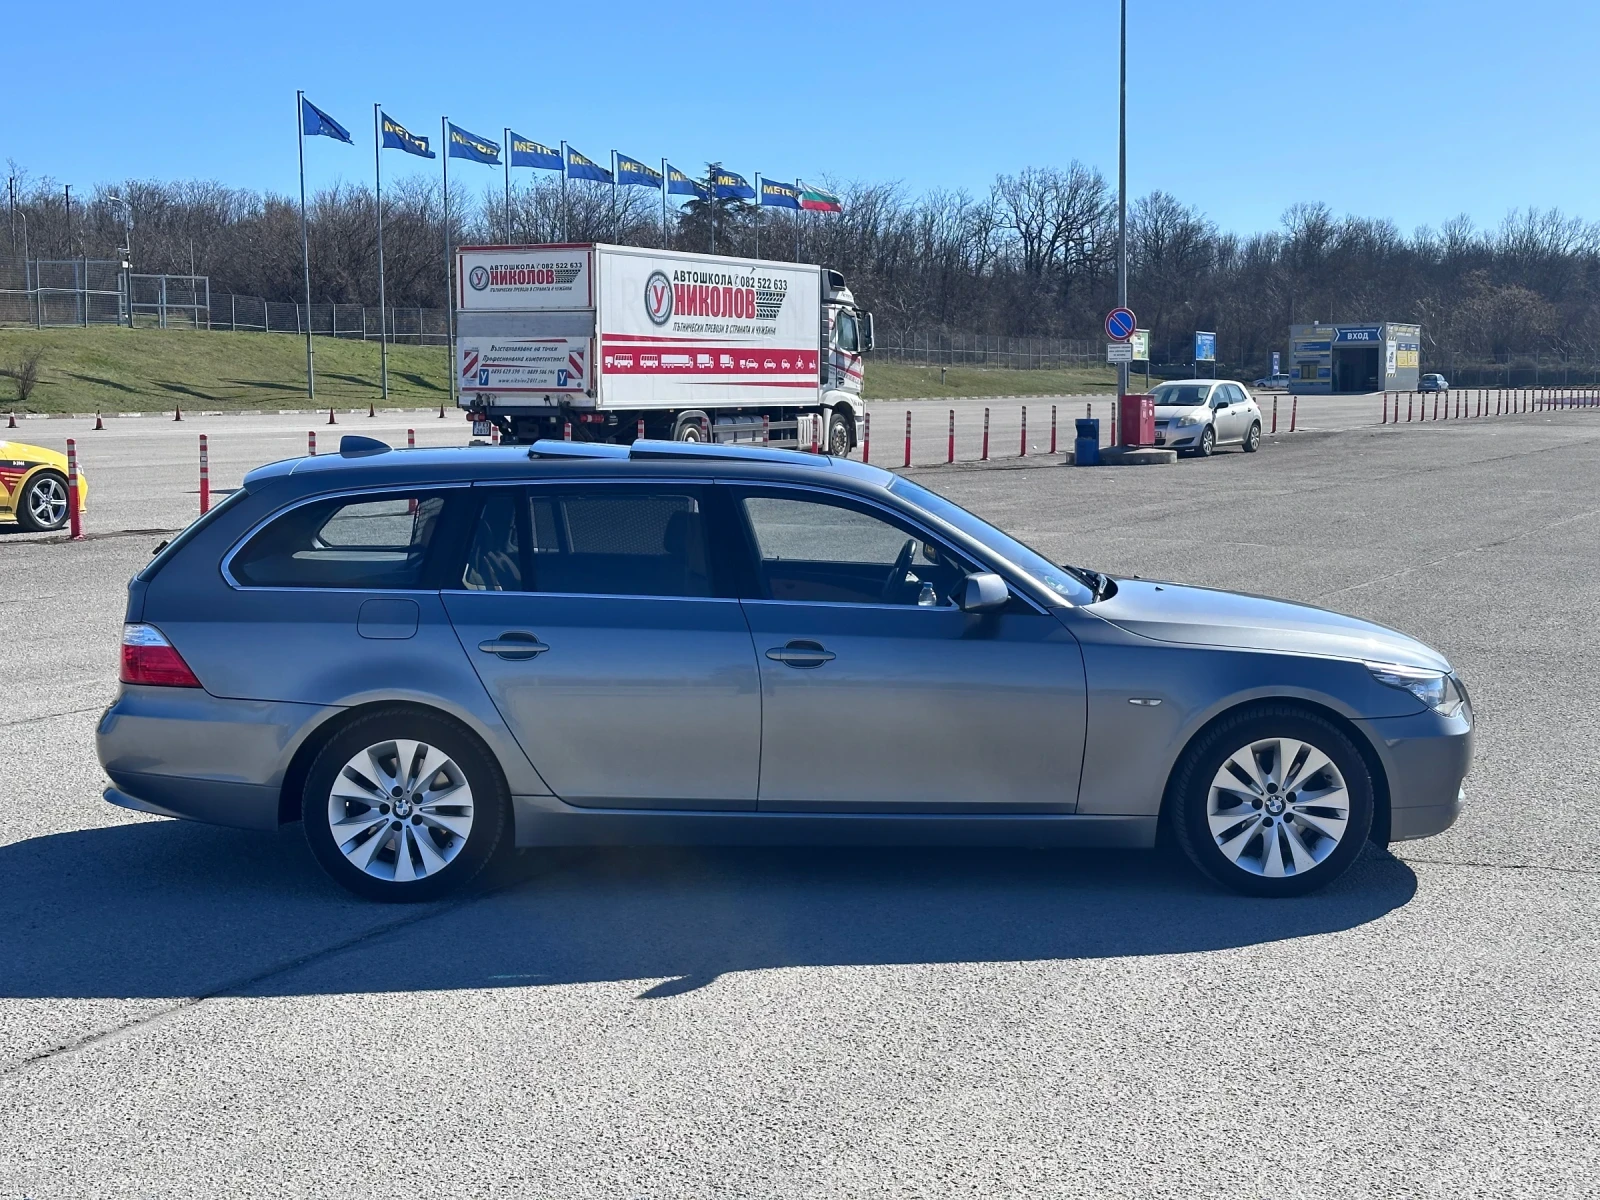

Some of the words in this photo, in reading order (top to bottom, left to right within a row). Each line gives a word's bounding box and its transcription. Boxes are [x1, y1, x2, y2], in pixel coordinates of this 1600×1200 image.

[490, 263, 535, 271] АВТОШКОЛА
[569, 261, 582, 269] 633
[490, 269, 555, 286] НИКОЛОВ
[673, 269, 733, 286] АВТОШКОЛА
[740, 275, 755, 288] 082
[757, 277, 772, 289] 522
[773, 279, 788, 291] 633
[673, 283, 756, 319] НИКОЛОВ
[704, 323, 725, 334] ПРЕВОЗИ
[725, 324, 729, 334] В
[729, 324, 751, 335] СТРАНАТА
[1347, 332, 1369, 341] ВХОД
